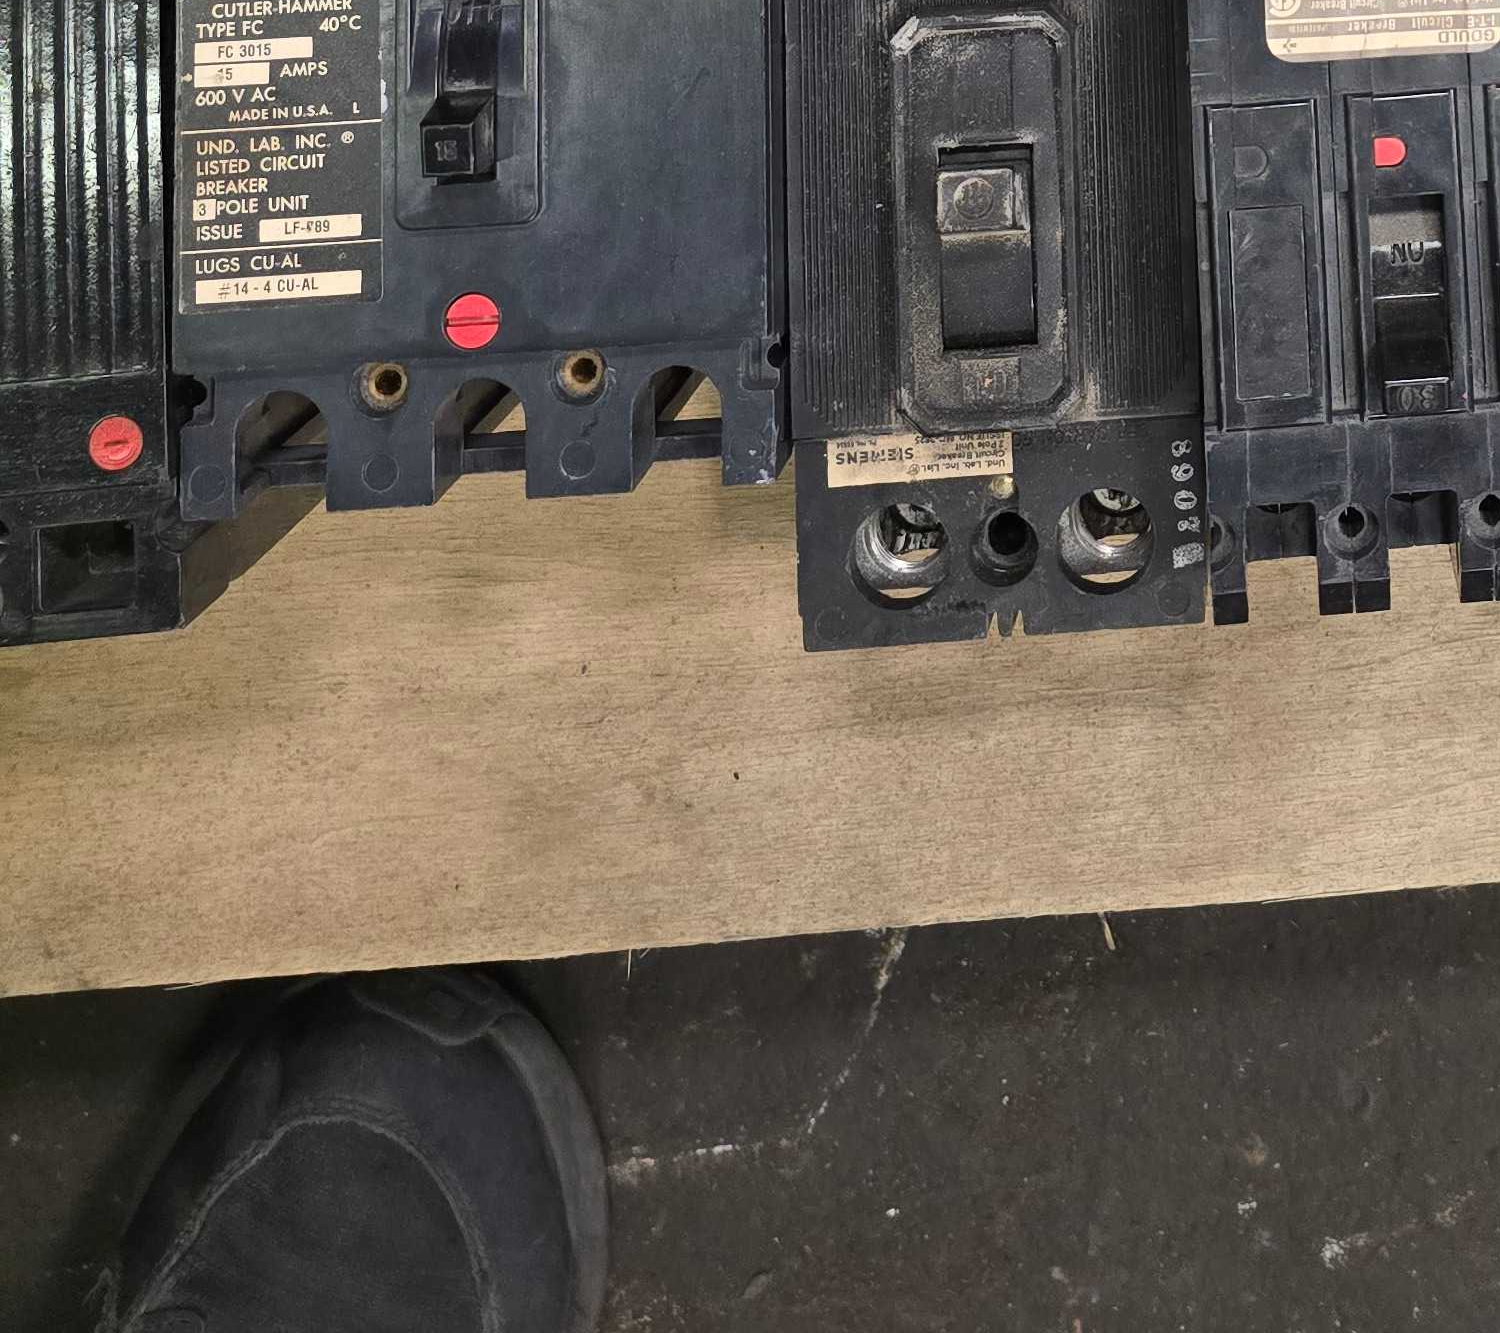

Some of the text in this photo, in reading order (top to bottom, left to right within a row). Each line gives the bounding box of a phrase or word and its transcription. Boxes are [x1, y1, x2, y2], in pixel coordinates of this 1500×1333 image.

[195, 15, 361, 39] TYPE FC 40°C
[1437, 29, 1496, 44] GOULD
[218, 43, 271, 58] FC 3015
[280, 61, 328, 77] AMPS
[195, 86, 276, 106] 600 V AC
[228, 109, 269, 122] MADE
[273, 107, 288, 119] IN
[293, 104, 333, 117] U.S.A.
[197, 133, 331, 155] UND. LAB. INC.
[196, 153, 326, 177] LISTED CIRCUIT
[196, 178, 268, 197] BREAKER
[198, 195, 309, 217] 3 POLE UNIT
[196, 223, 243, 241] ISSUE
[196, 252, 302, 274] LUGS CU-AL
[218, 282, 248, 296] #14
[263, 280, 271, 293] 4
[277, 277, 319, 292] CU-AL
[835, 446, 915, 466] SIEMENS
